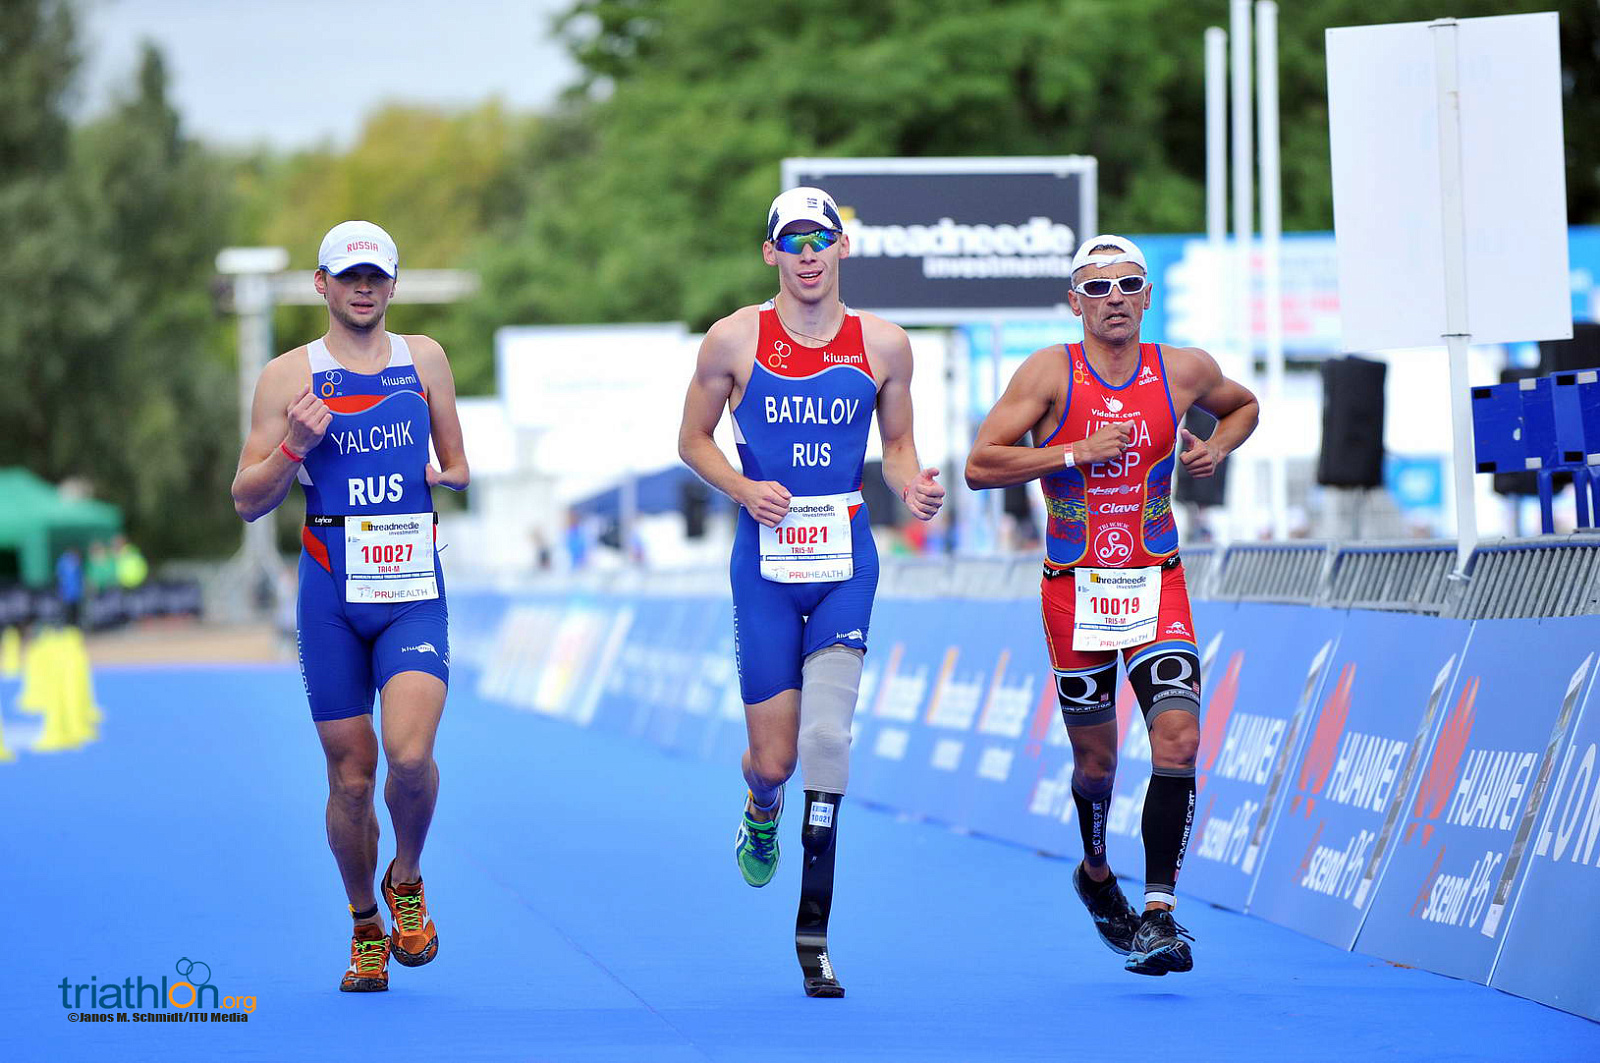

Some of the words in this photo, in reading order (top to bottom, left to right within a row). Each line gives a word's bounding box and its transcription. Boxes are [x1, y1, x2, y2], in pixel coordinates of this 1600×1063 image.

[849, 217, 1074, 257] hreadneedle
[347, 241, 378, 252] RUSSIA
[823, 351, 863, 364] kiwami
[381, 374, 417, 386] kiwami
[765, 396, 859, 425] BATALOV
[1091, 408, 1141, 418] Vidolex.com
[331, 420, 414, 455] YALCHIK
[792, 442, 832, 467] RUS
[348, 473, 404, 506] RUS
[789, 504, 834, 512] readneedle
[1099, 503, 1140, 514] Clave
[367, 521, 419, 532] threadneedle
[775, 526, 828, 544] 10021
[361, 543, 413, 564] 10027
[378, 565, 400, 574] TRI4-M
[789, 570, 843, 579] PRUHEALTH
[1096, 575, 1146, 585] threadneedle
[374, 589, 428, 599] PRUHEALTH
[1090, 597, 1140, 616] 10019
[1100, 634, 1148, 647] PRUHEALTH
[1215, 713, 1288, 786] HUAWEI
[1326, 731, 1408, 813] HUAWEI
[1446, 749, 1538, 831] HUAWEI
[1535, 743, 1600, 868] LON
[811, 815, 831, 823] 10021
[1336, 829, 1375, 900] P6
[1459, 851, 1503, 928] P6
